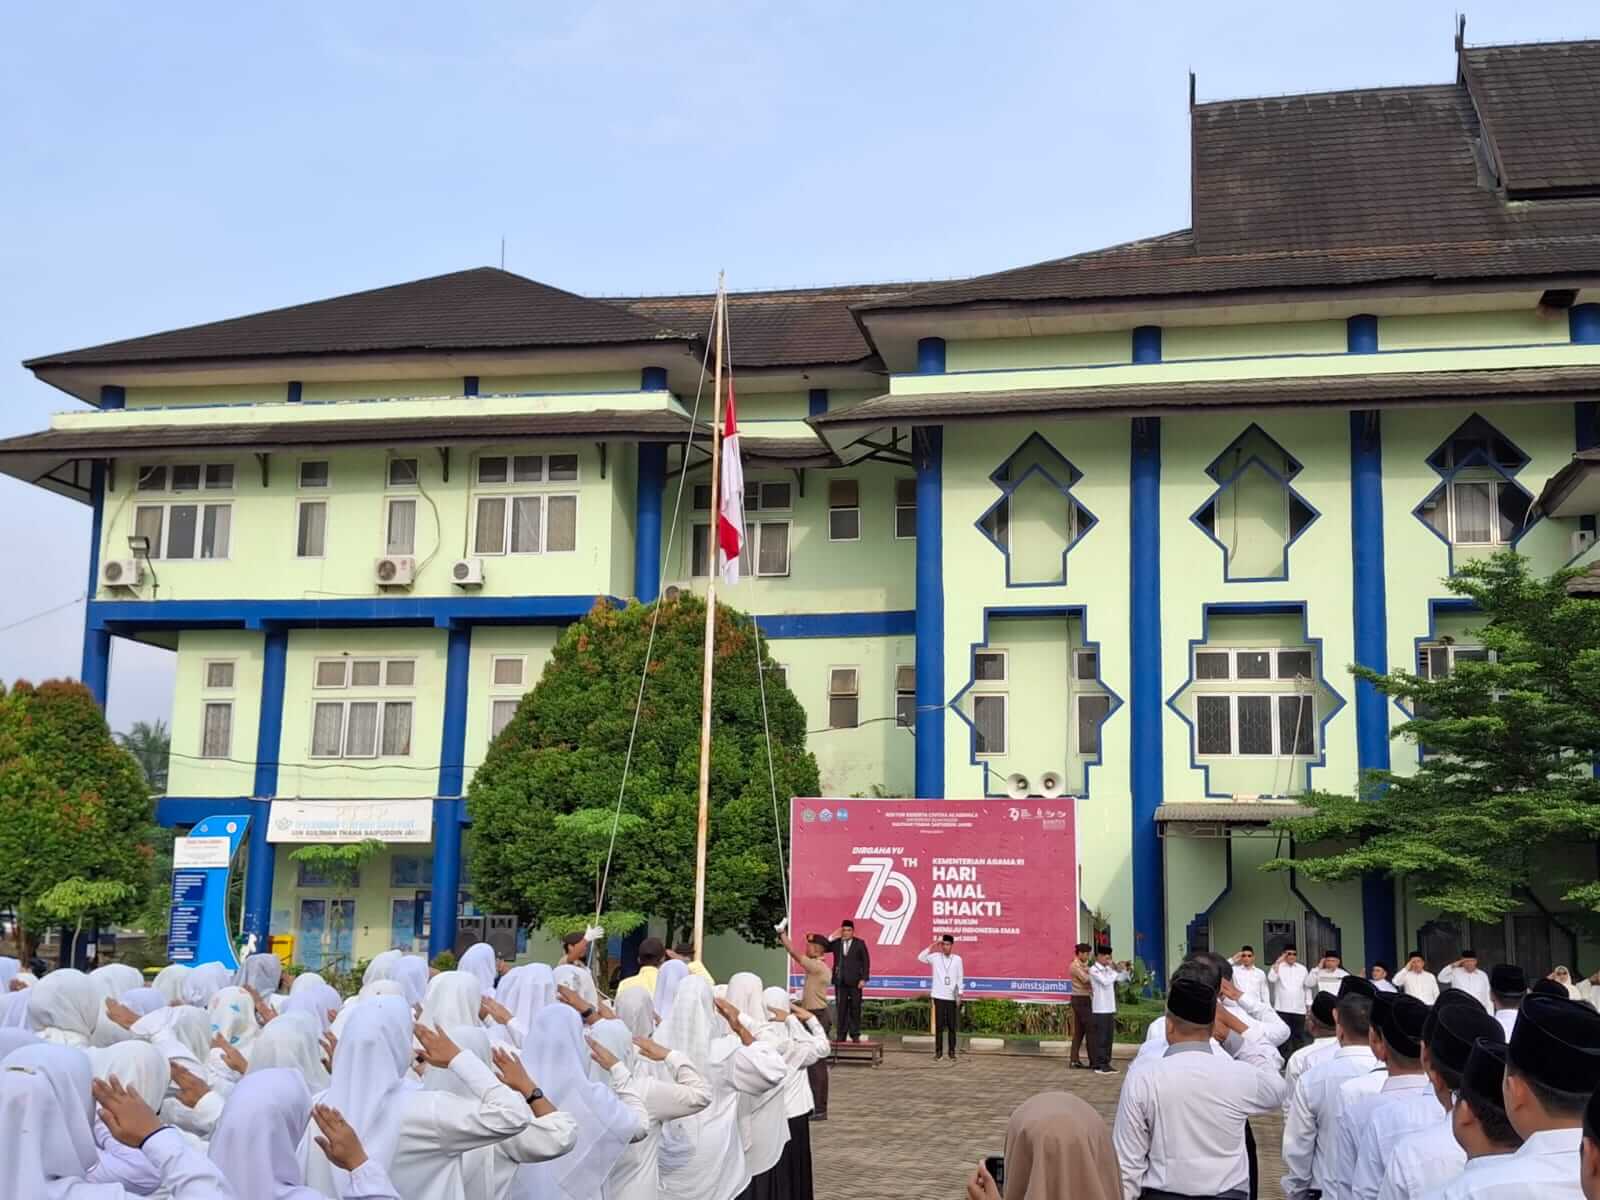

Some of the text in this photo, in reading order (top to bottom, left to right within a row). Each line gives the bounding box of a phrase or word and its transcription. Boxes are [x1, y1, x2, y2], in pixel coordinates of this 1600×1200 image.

[932, 866, 977, 881] HARI
[932, 884, 985, 898] AMAL
[848, 857, 918, 945] 79
[902, 858, 918, 867] TH
[932, 901, 1001, 916] BHAKTI
[1010, 980, 1067, 992] #uinstsjambi
